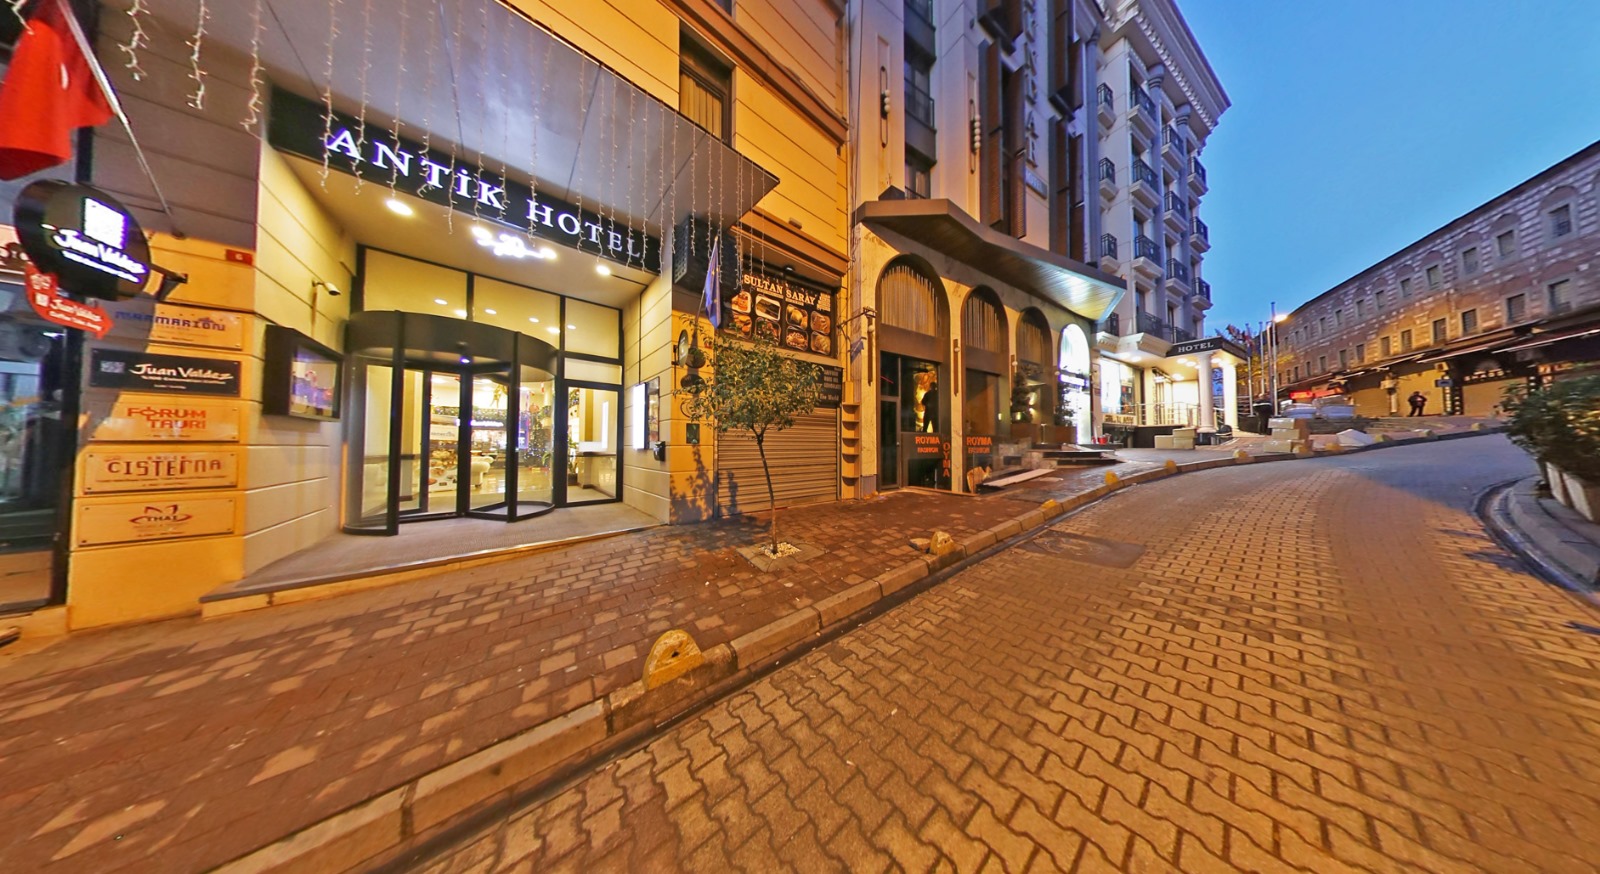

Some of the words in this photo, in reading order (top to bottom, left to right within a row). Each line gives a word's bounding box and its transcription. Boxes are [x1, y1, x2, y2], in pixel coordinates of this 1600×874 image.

[526, 198, 641, 258] HOTEL
[742, 273, 785, 295] SULTAN
[785, 289, 816, 306] SARAY
[1178, 341, 1214, 353] HOTEL
[128, 363, 177, 377] Juan
[178, 367, 234, 380] Valdez
[127, 407, 207, 419] FORUM
[148, 419, 207, 429] TAURI
